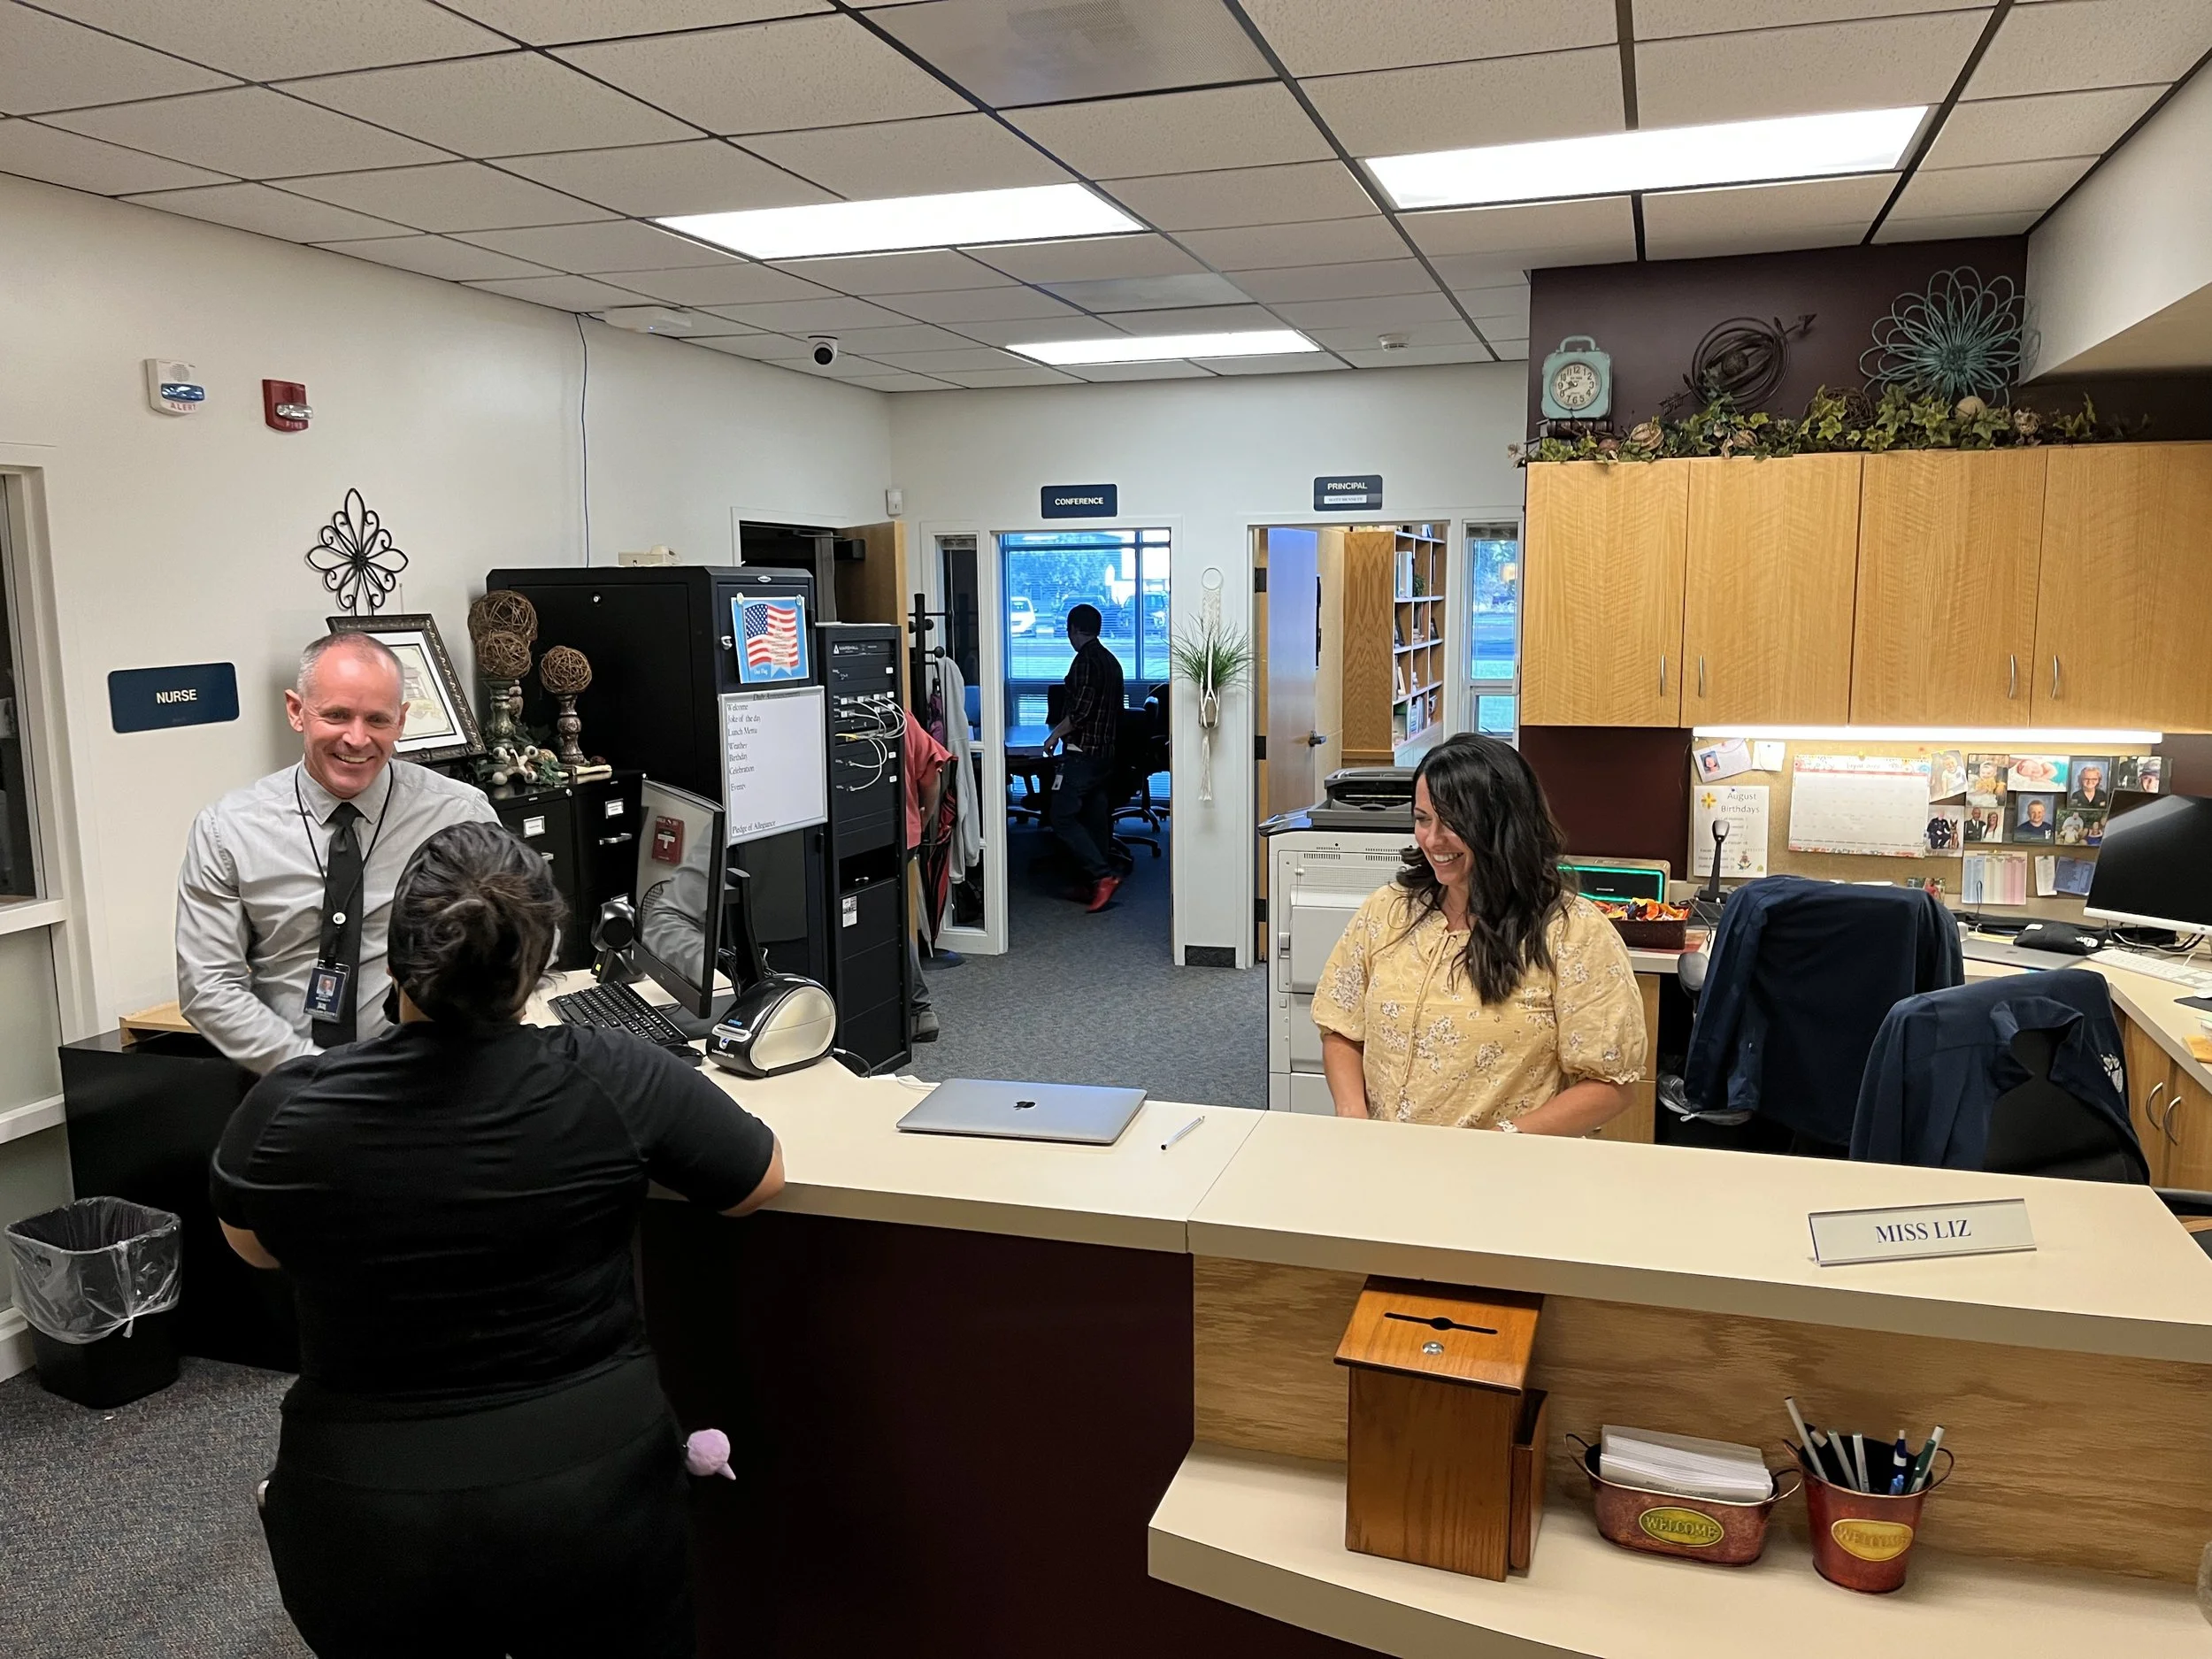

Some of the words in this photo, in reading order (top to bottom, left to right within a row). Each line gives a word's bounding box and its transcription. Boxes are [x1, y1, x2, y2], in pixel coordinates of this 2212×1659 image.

[170, 403, 197, 411] ALERT
[157, 689, 197, 703] NURSE
[727, 727, 743, 736] Lunch
[1727, 793, 1756, 802] August
[1721, 805, 1760, 814] Birthdays
[1875, 1222, 1929, 1243] MISS
[1932, 1219, 1972, 1239] LIZ
[1646, 1516, 1719, 1538] WELCOME
[1835, 1525, 1910, 1548] WELCOME
